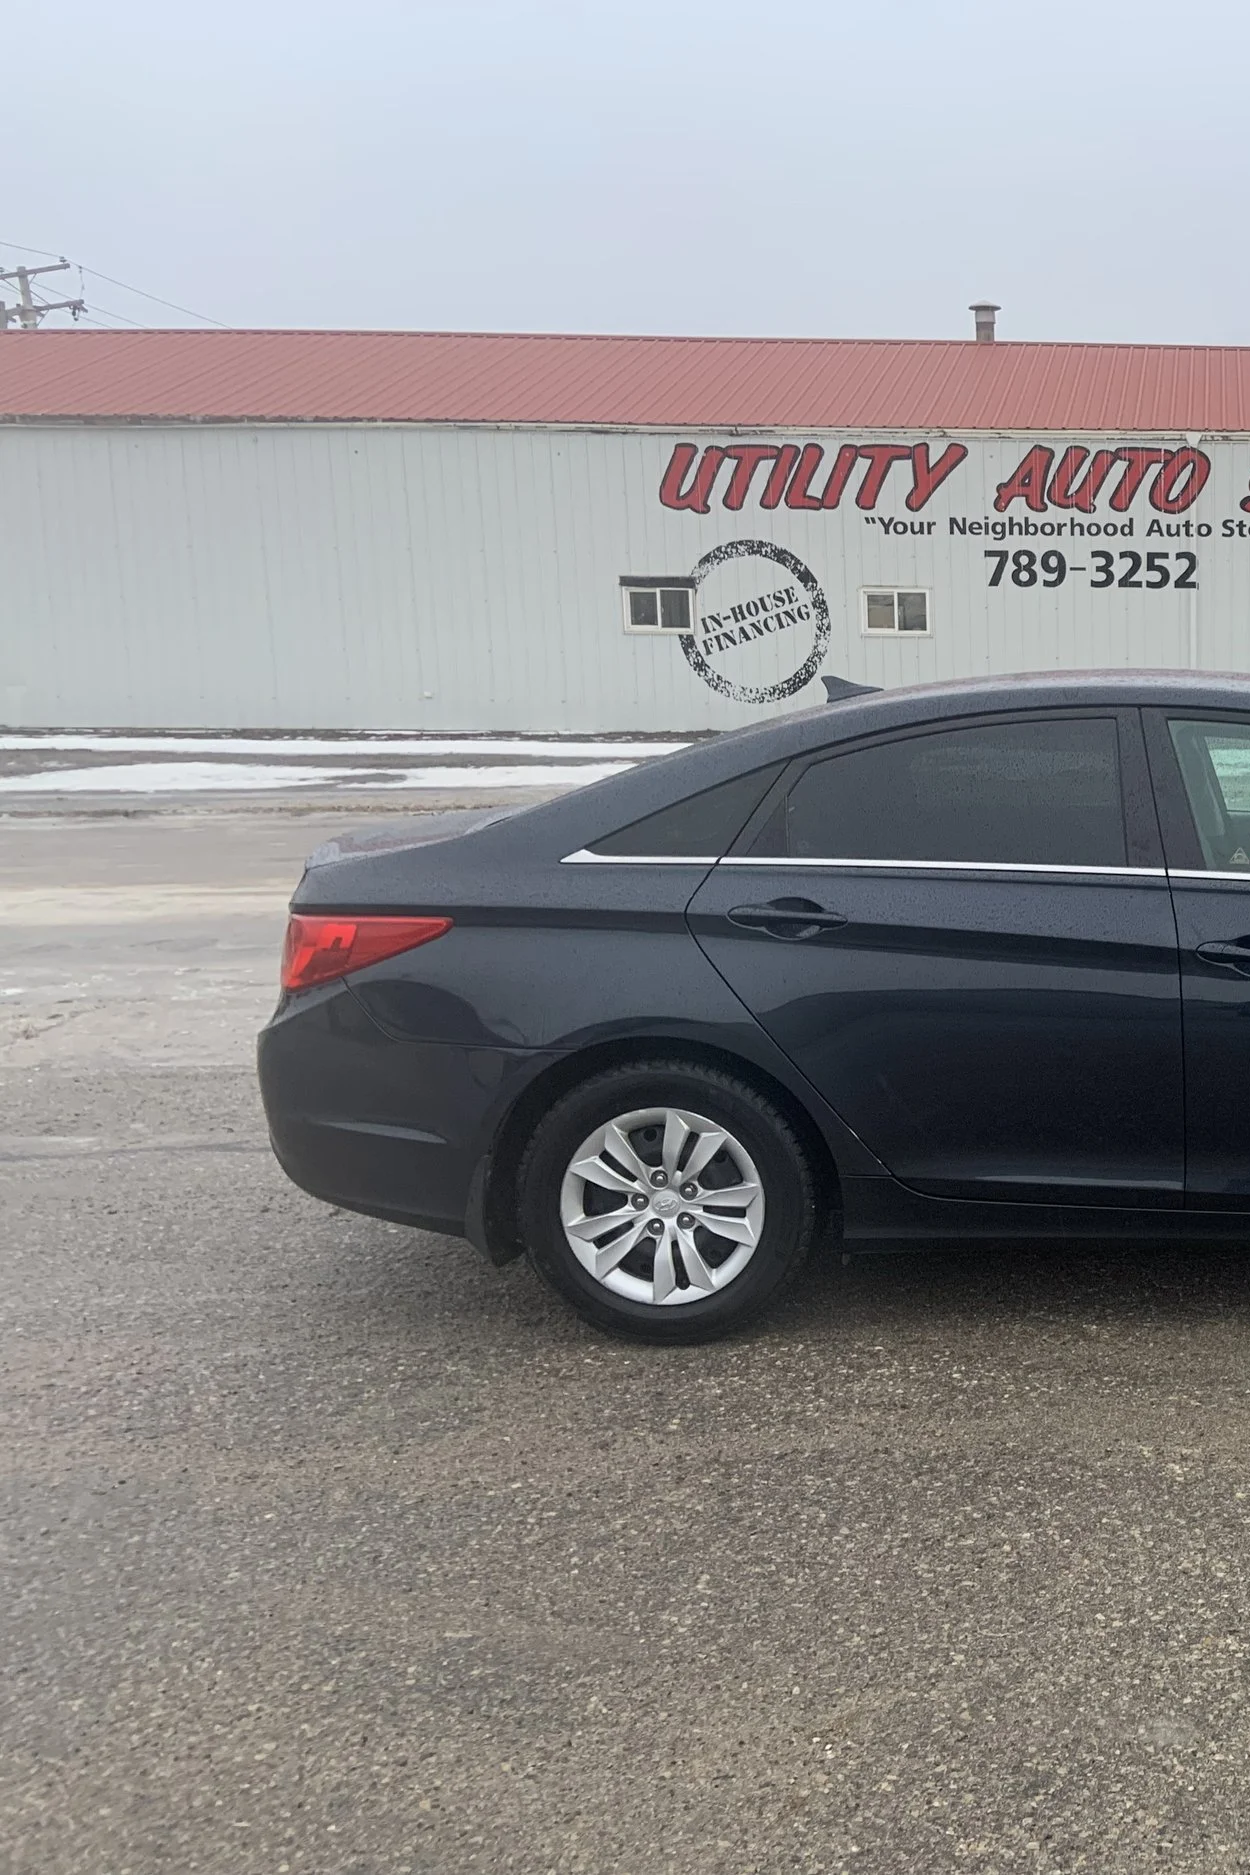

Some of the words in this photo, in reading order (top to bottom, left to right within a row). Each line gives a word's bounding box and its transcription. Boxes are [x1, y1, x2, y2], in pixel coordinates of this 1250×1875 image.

[660, 443, 968, 514] UTILITY
[994, 445, 1211, 514] AUTO
[949, 516, 1134, 541] Neighborhood
[1145, 518, 1213, 538] Auto
[983, 549, 1198, 589] 789-3252
[700, 586, 800, 634] IN-HOUSE
[701, 604, 812, 656] FINANCING
